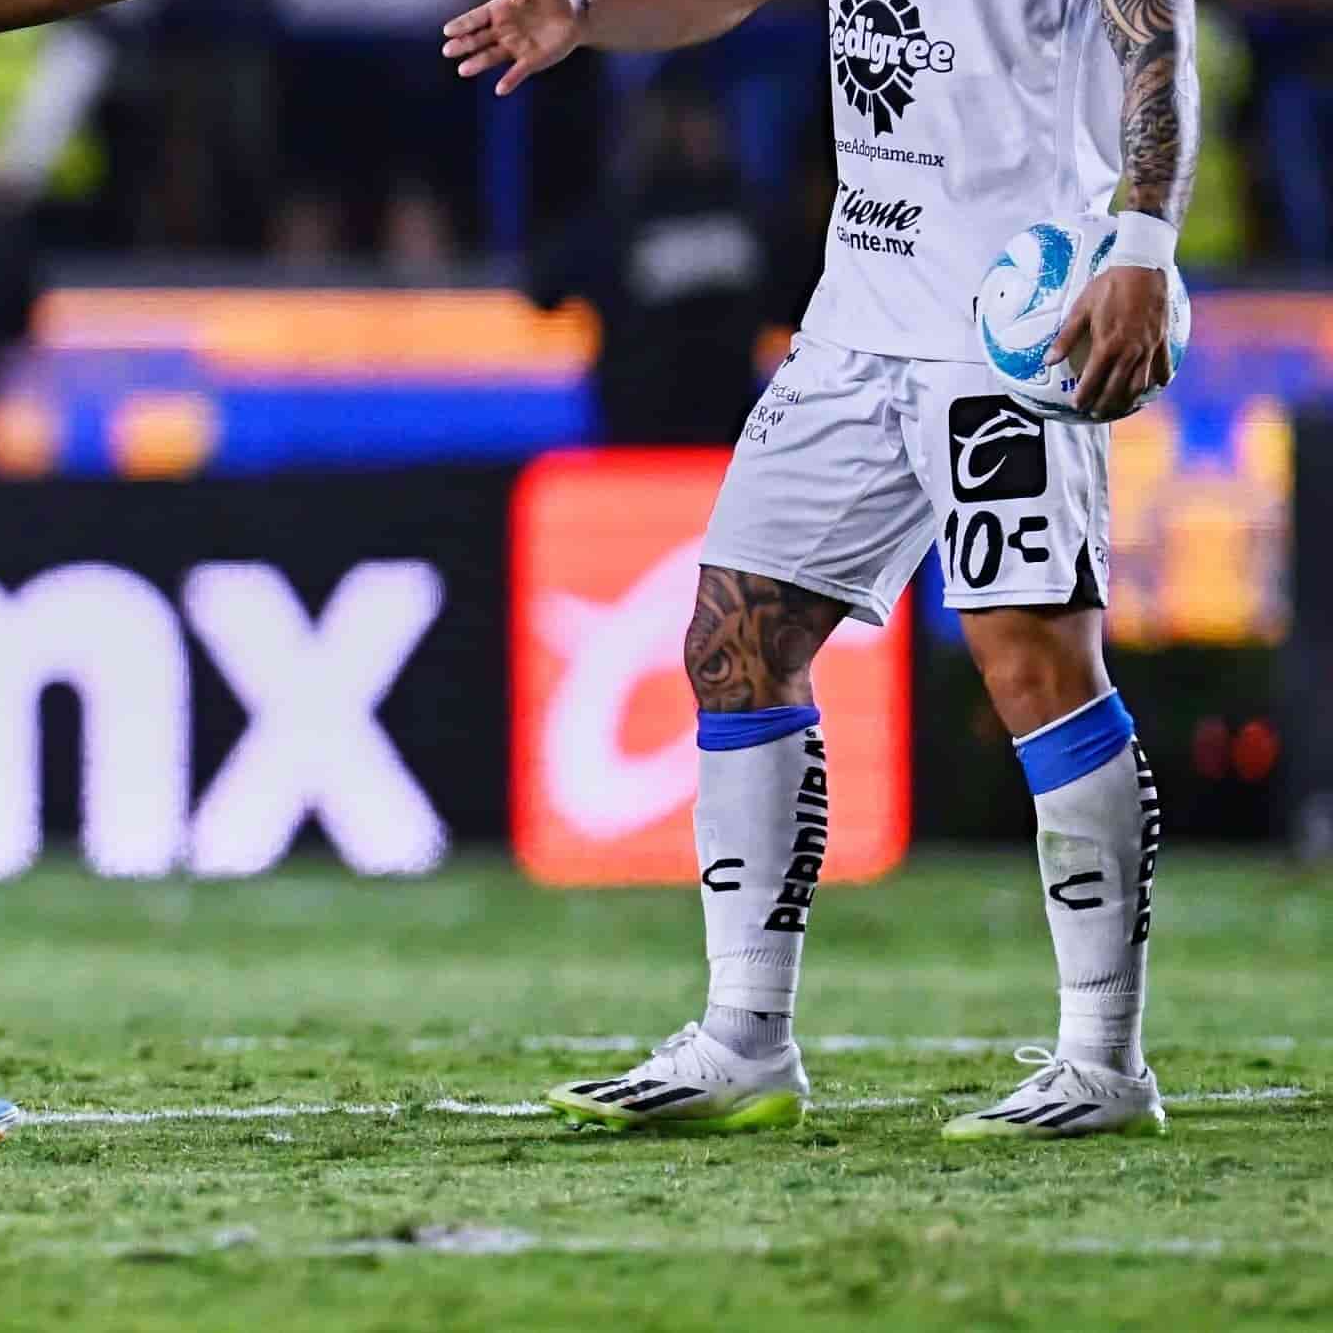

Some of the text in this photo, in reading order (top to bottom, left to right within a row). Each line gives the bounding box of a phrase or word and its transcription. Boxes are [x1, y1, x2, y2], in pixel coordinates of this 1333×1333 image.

[831, 8, 955, 74] edigree
[835, 138, 945, 168] eeAdoptame.mx
[944, 507, 1004, 589] 10
